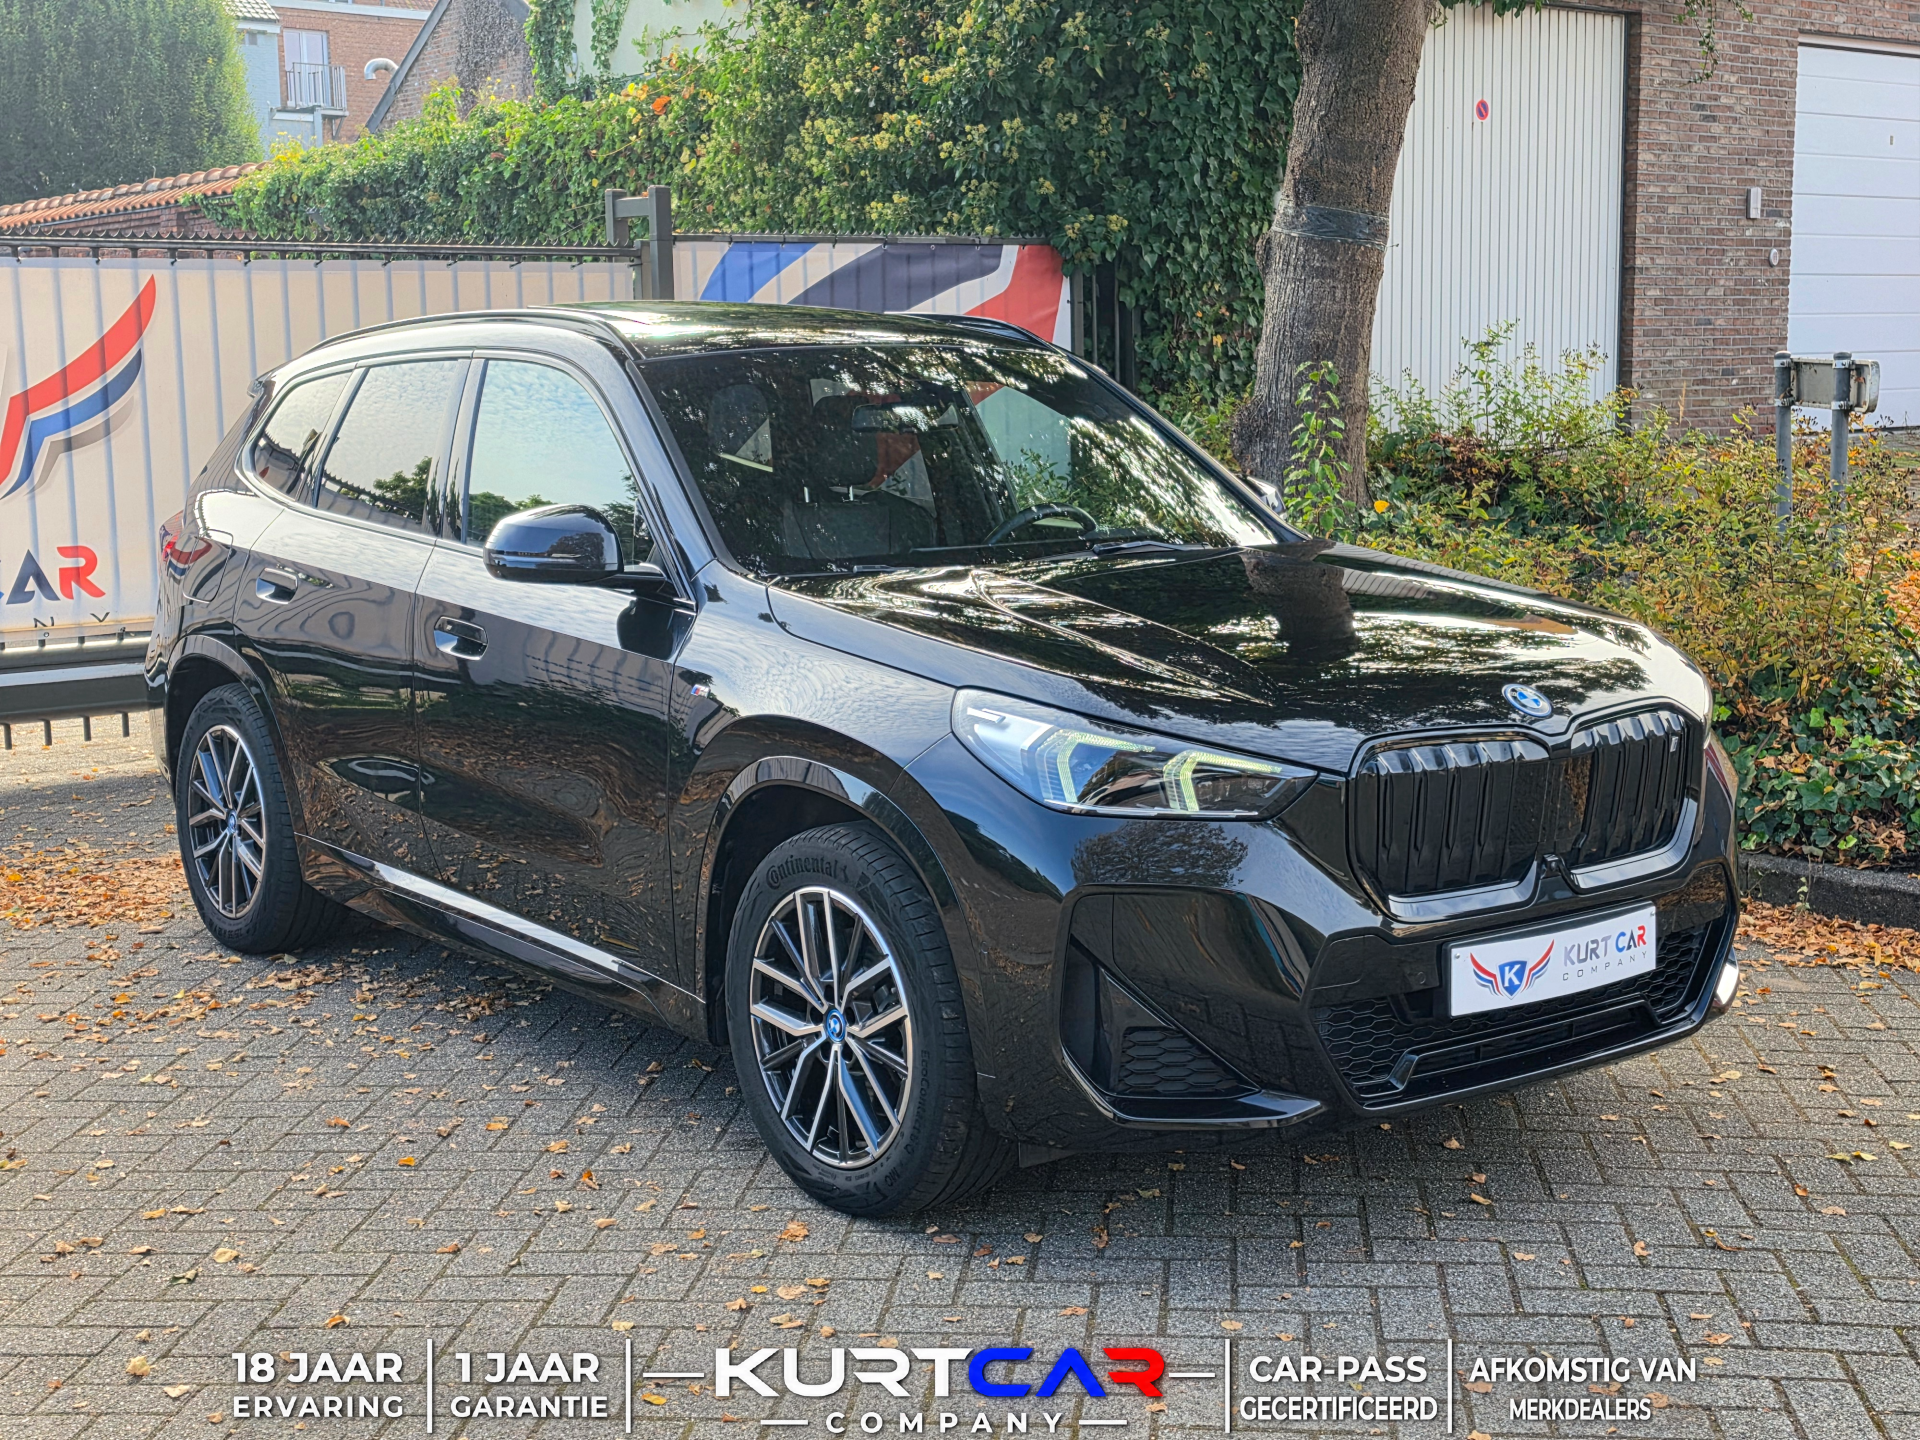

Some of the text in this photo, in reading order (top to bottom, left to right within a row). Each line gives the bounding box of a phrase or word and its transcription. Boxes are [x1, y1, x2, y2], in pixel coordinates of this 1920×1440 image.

[0, 545, 106, 605] AR
[766, 855, 838, 889] Continental
[1564, 924, 1647, 967] KURT CAR
[1504, 964, 1521, 987] K
[1562, 950, 1648, 981] COMPANY
